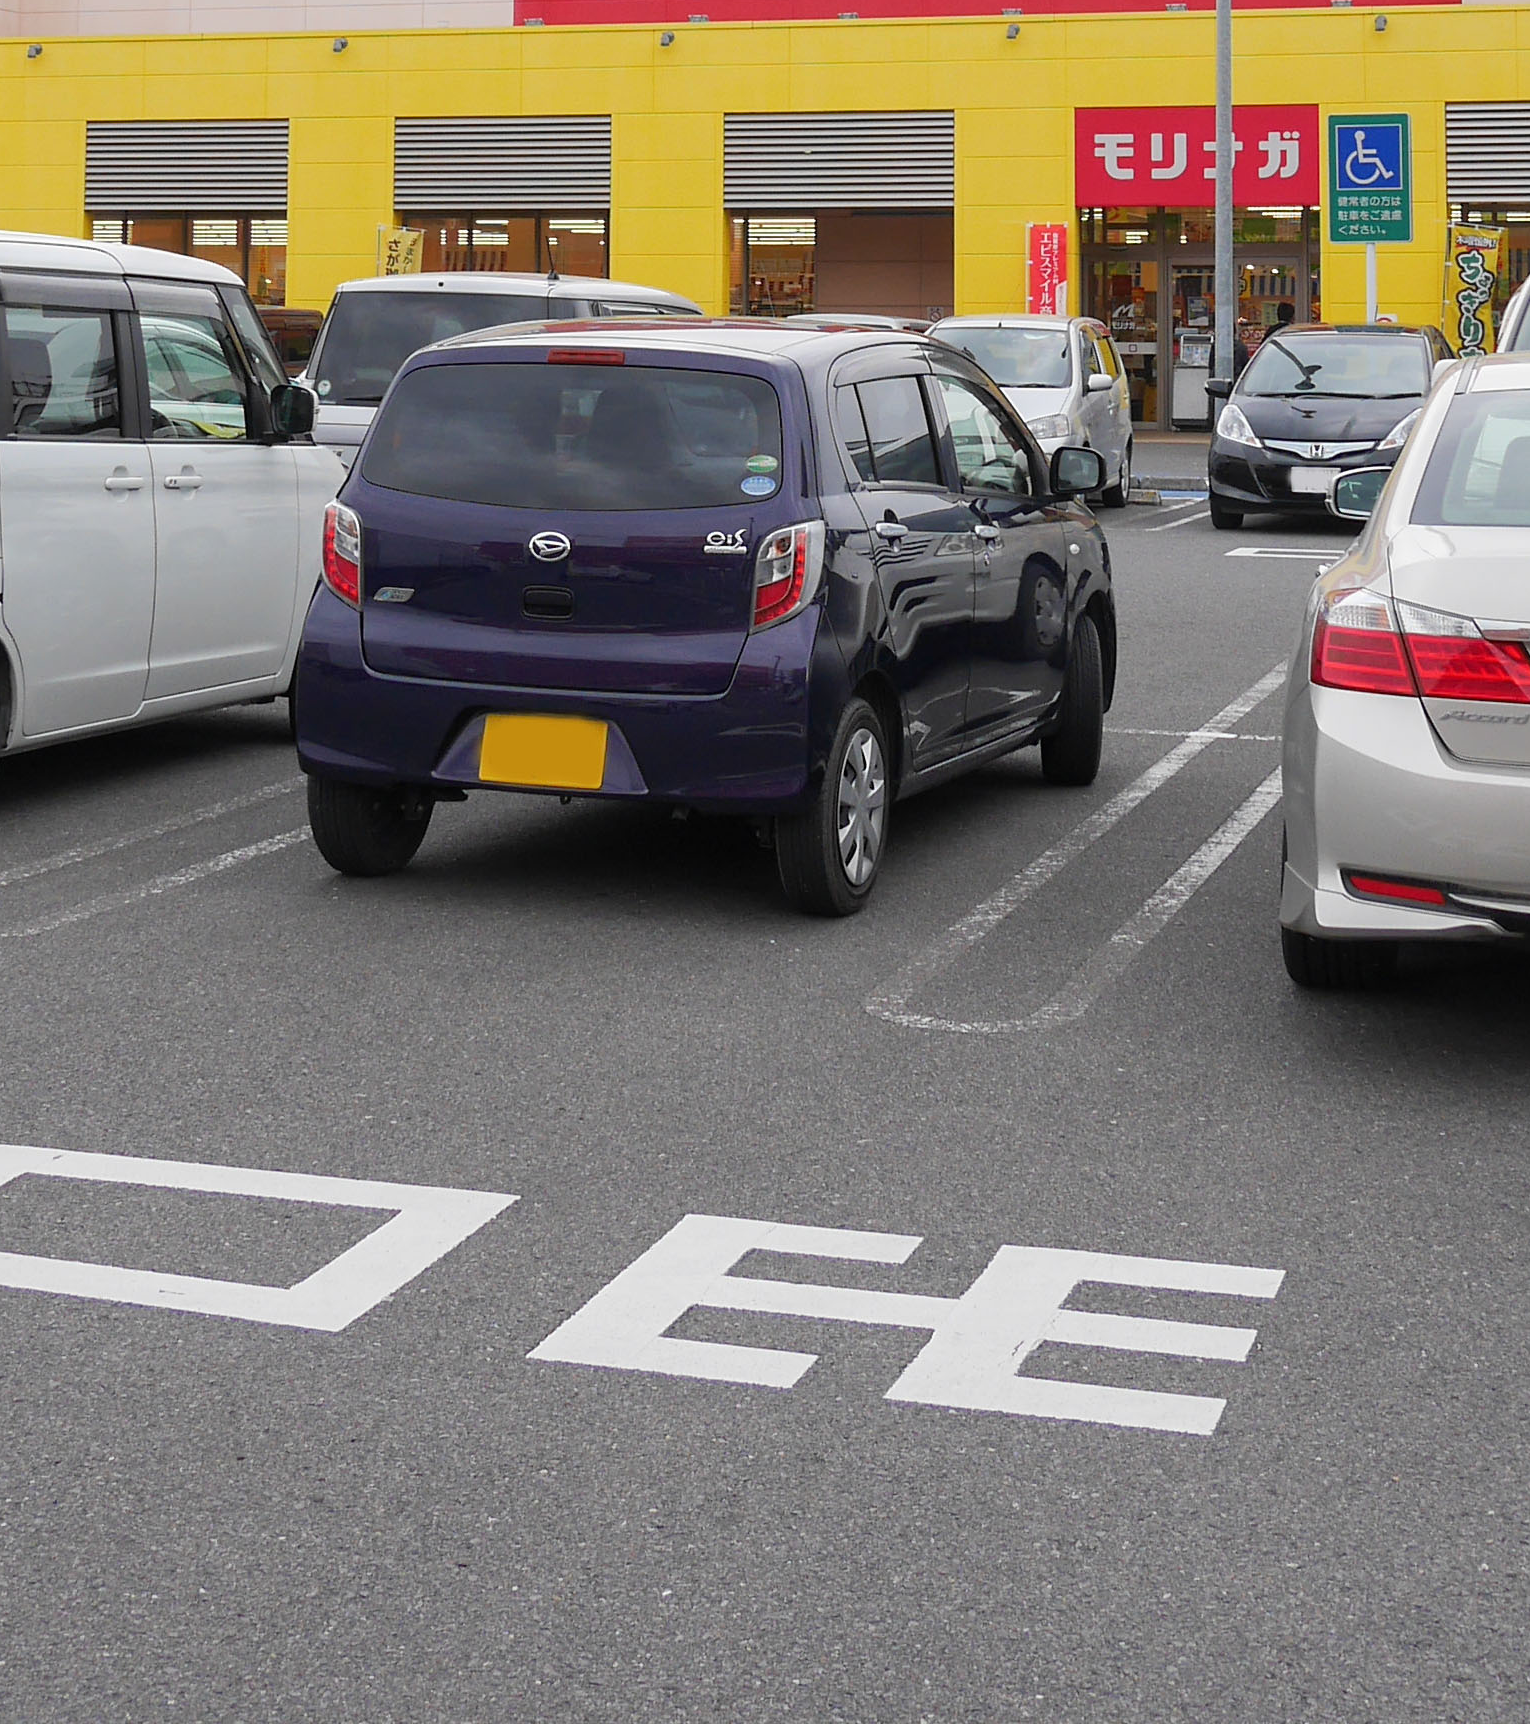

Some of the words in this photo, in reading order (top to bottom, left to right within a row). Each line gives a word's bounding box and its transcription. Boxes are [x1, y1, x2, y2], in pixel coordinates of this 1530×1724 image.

[1337, 196, 1403, 207] 健常者の方は
[1337, 210, 1404, 221] 駐車をご遠慮
[1338, 223, 1388, 235] ください。
[1439, 709, 1530, 725] Accord
